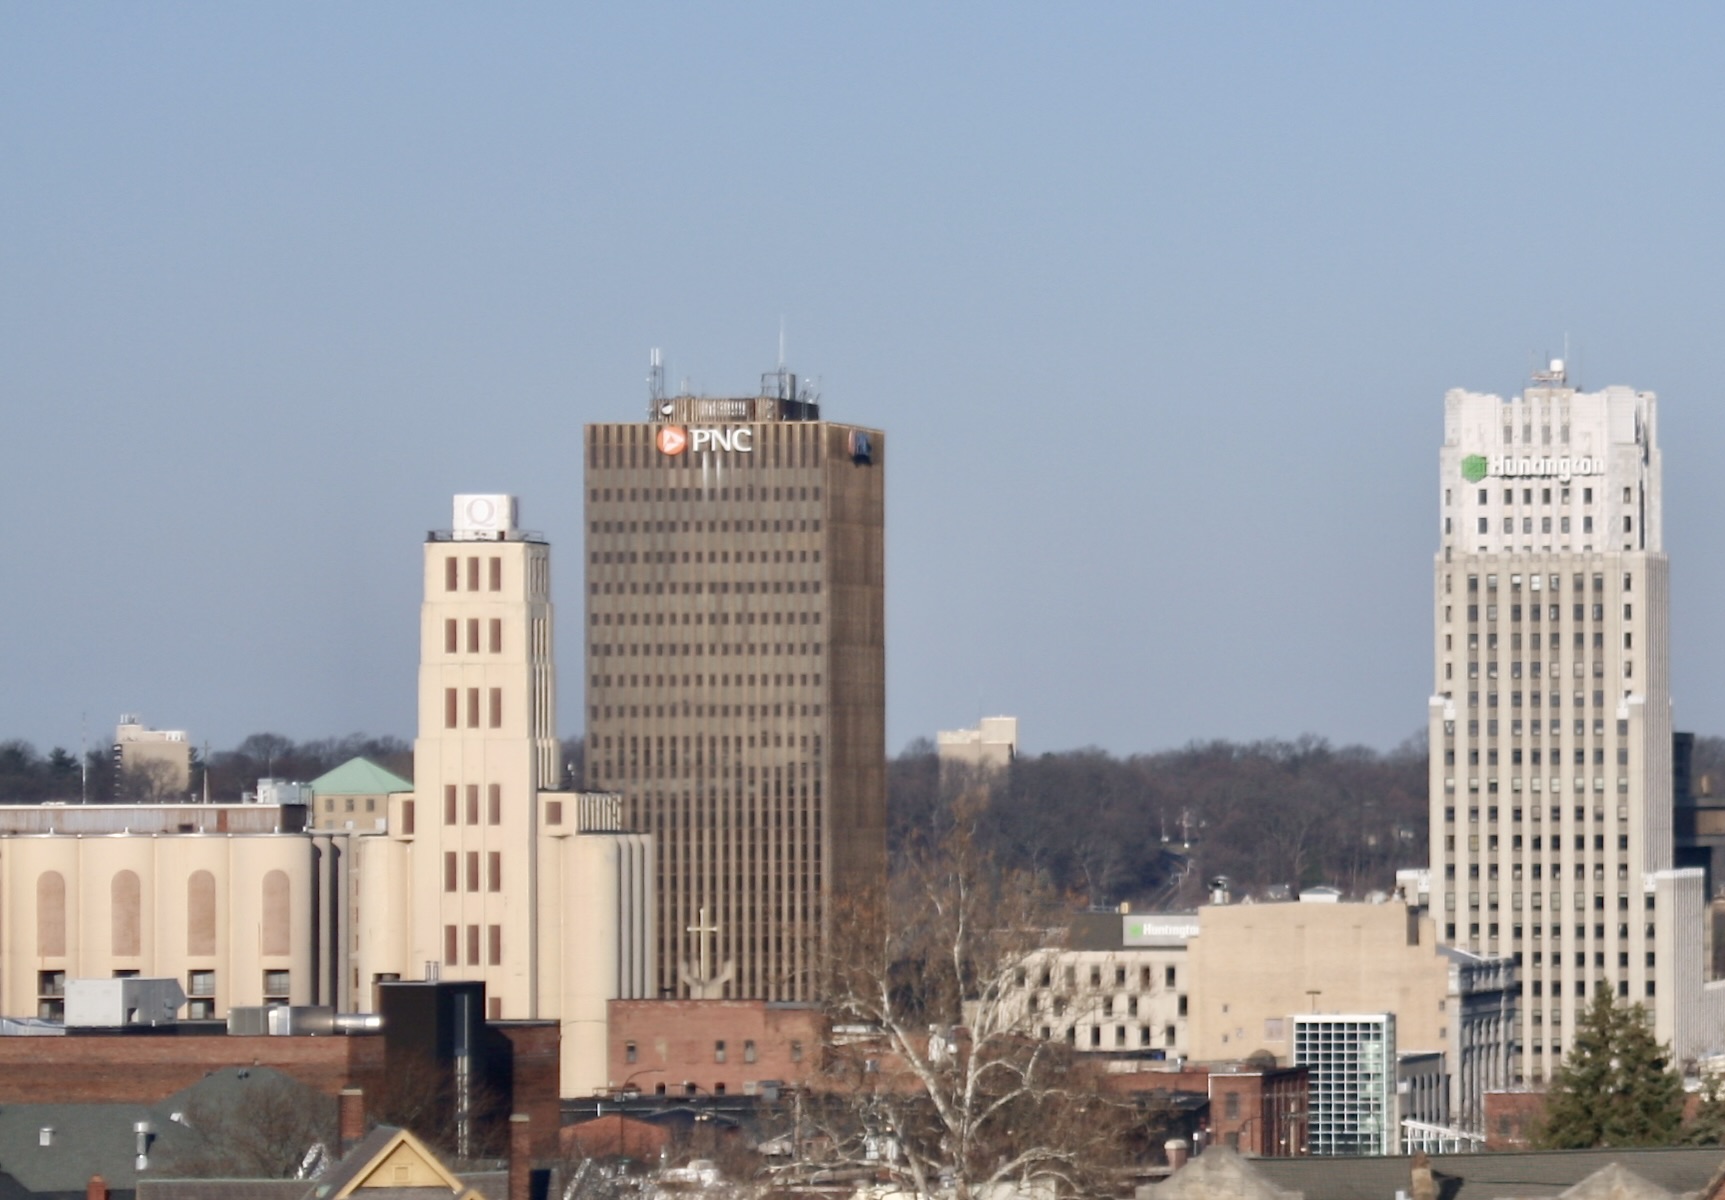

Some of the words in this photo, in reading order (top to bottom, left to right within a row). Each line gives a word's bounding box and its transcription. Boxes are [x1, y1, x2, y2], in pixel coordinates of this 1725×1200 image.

[690, 428, 752, 452] PNC
[1490, 454, 1604, 482] Huntington
[466, 498, 495, 528] Q
